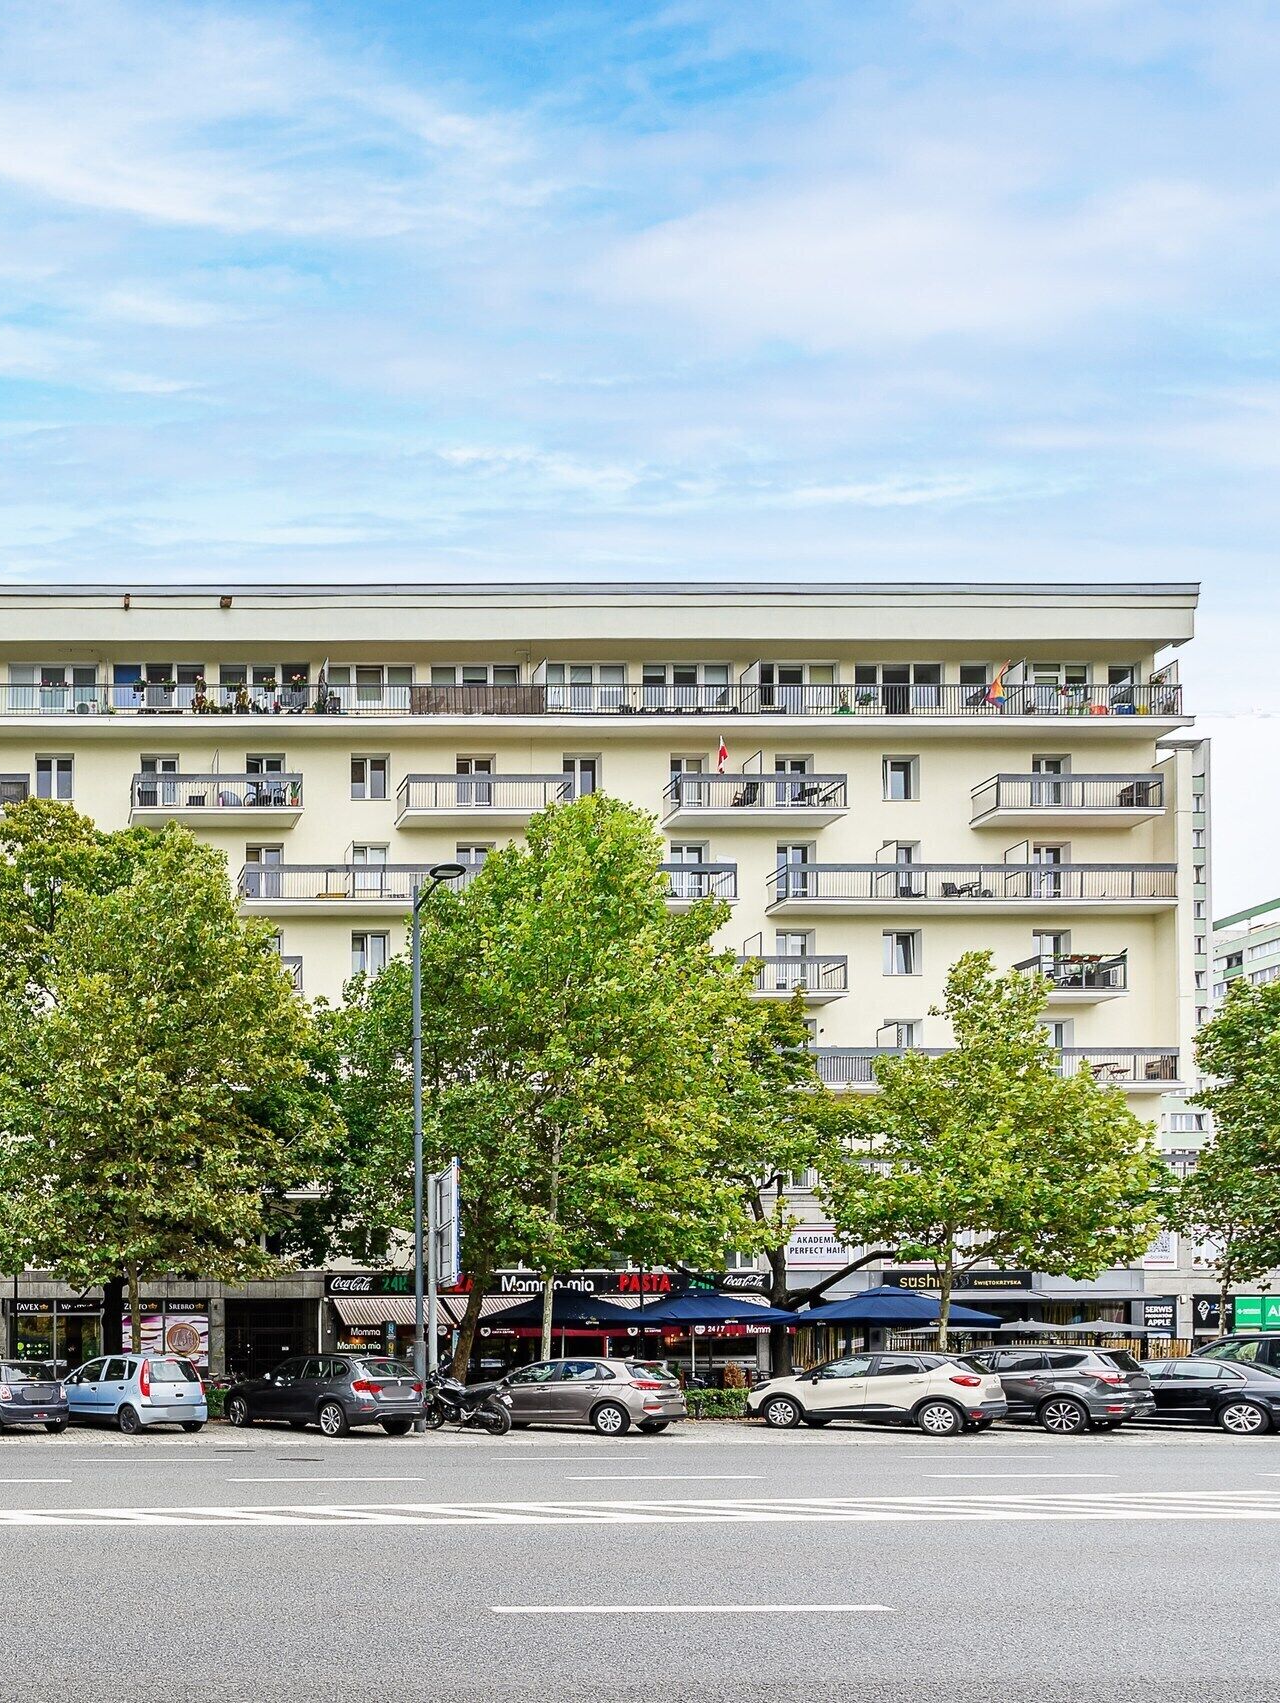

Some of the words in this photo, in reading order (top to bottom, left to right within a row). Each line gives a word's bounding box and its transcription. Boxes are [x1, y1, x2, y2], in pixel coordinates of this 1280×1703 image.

[790, 1246, 823, 1254] PERFECT
[826, 1246, 846, 1254] HAIR
[619, 1273, 671, 1292] PASTA
[168, 1302, 195, 1310] SREBRO
[1144, 1305, 1173, 1313] SERWIS
[1267, 1304, 1280, 1317] A
